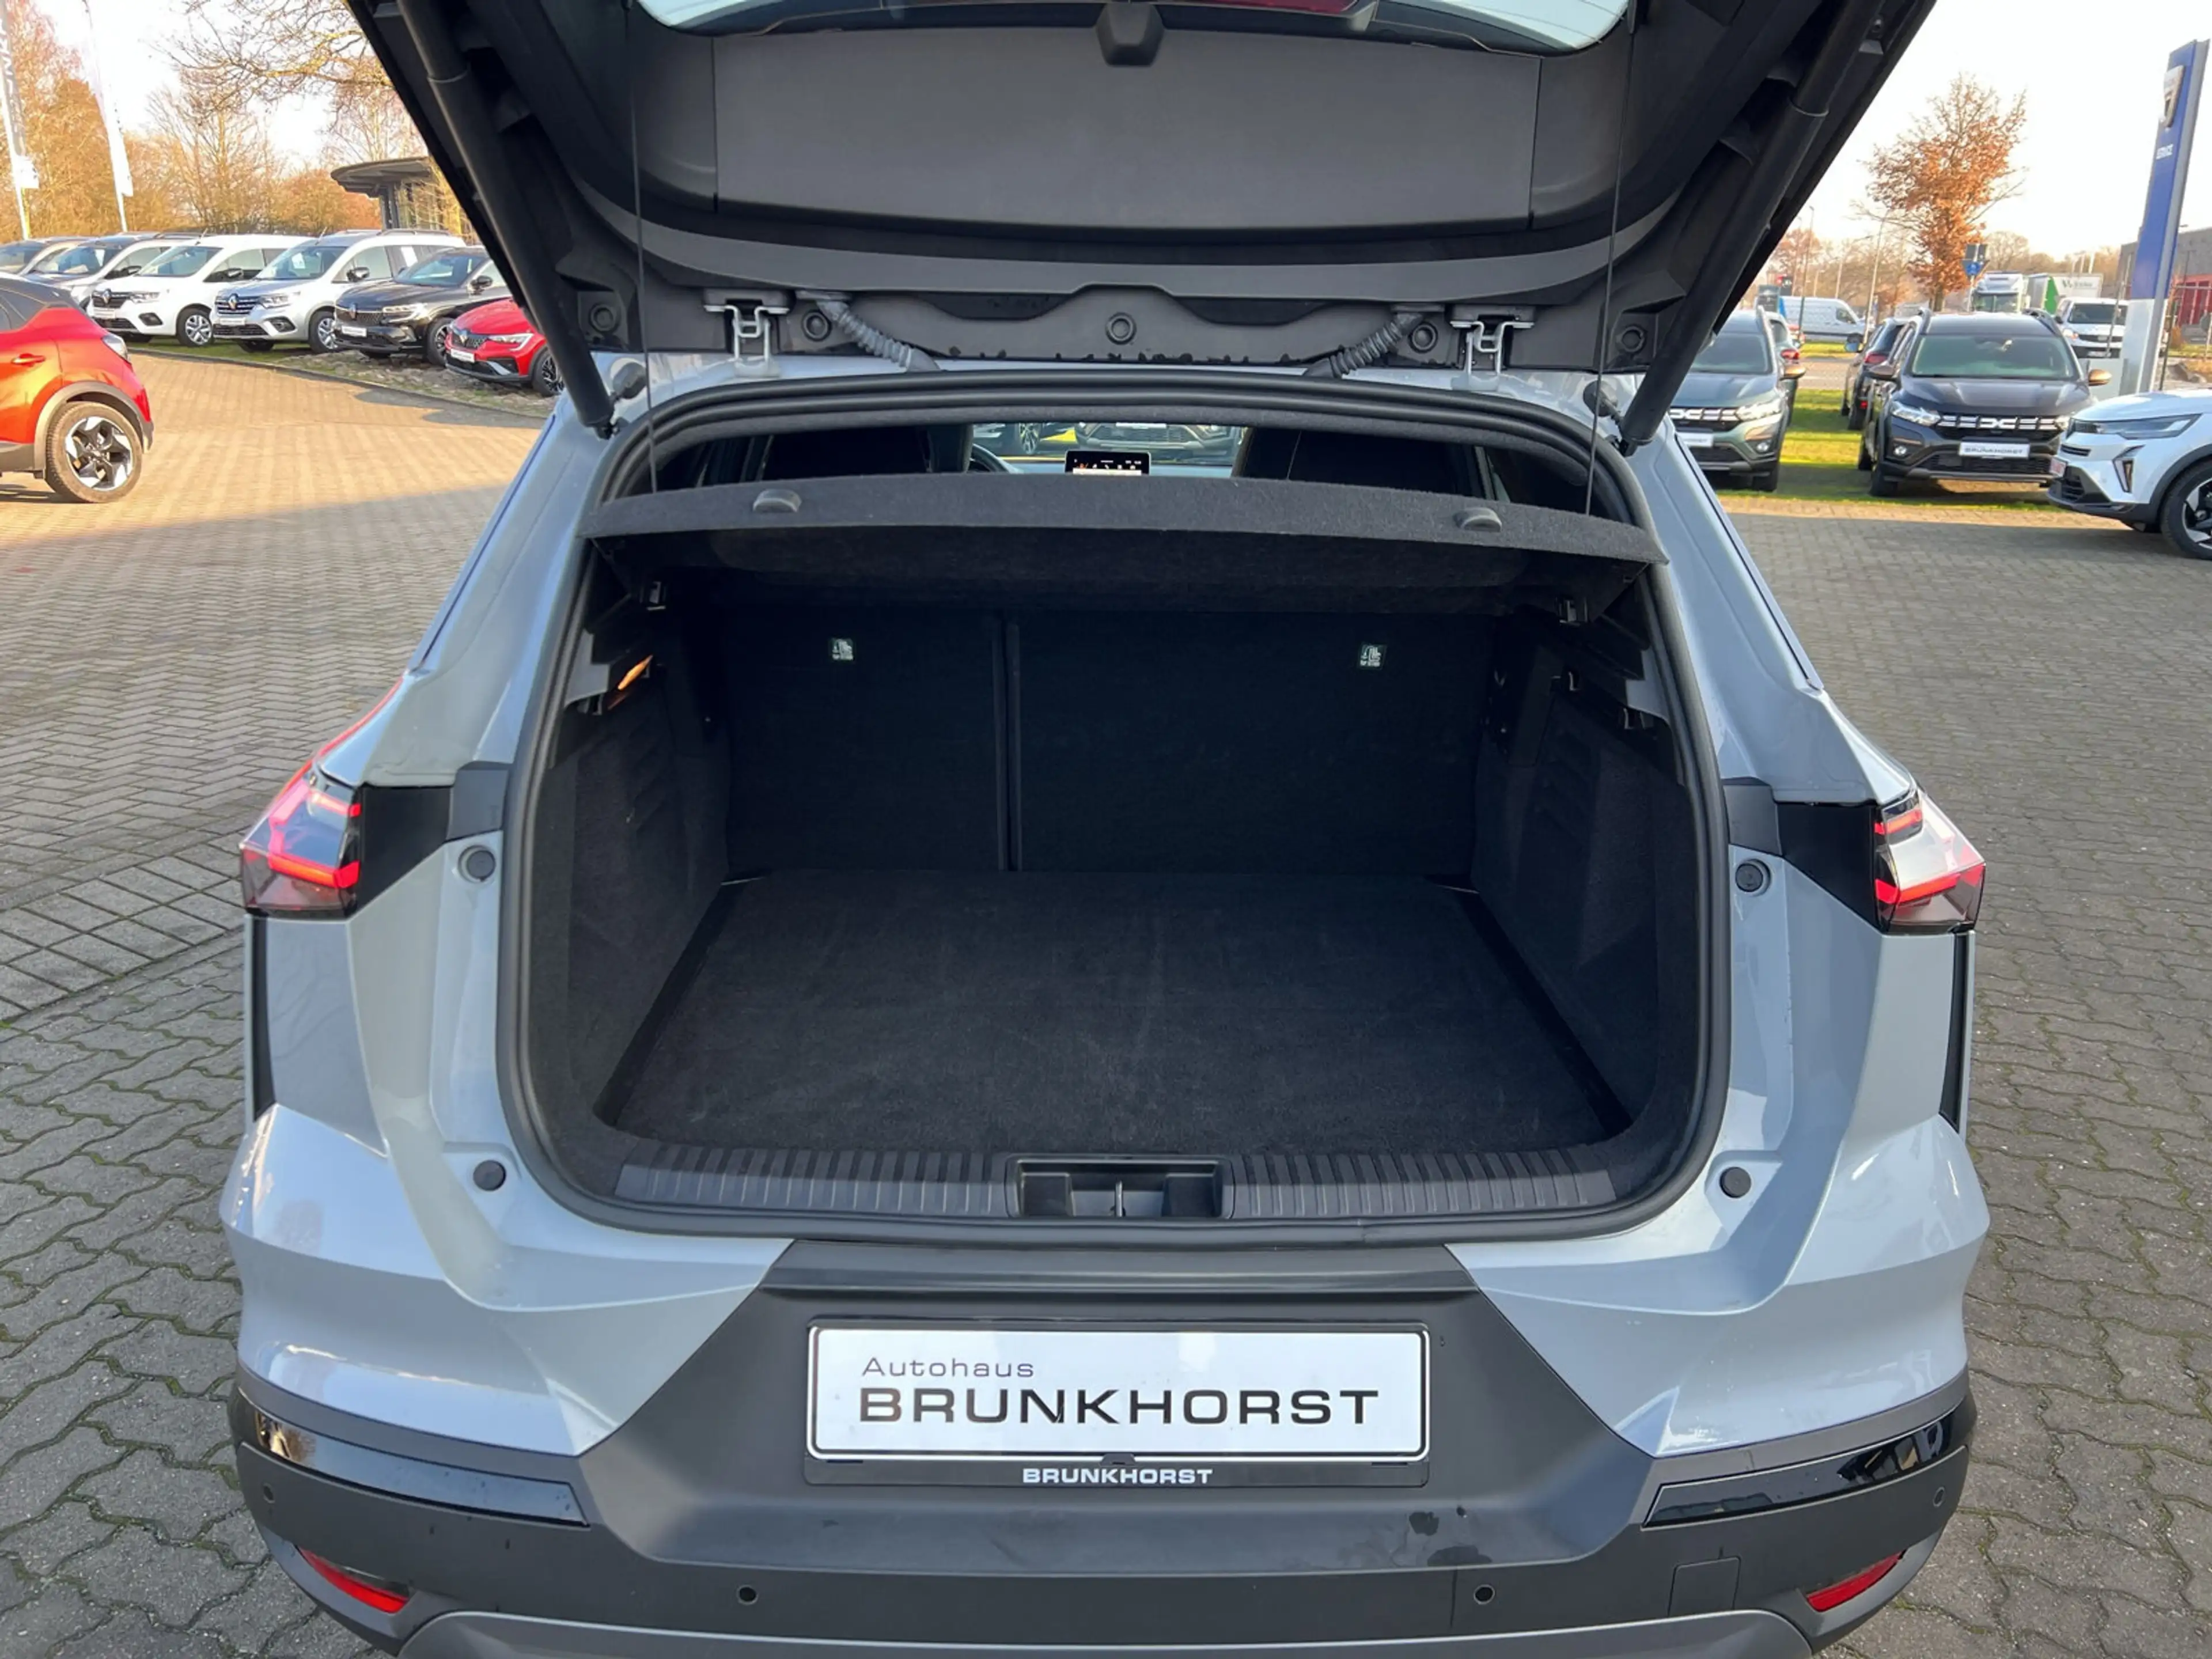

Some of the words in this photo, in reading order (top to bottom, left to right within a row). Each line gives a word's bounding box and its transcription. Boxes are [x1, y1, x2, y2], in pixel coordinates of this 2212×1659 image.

[862, 1357, 1035, 1378] Autohaus
[859, 1387, 1379, 1425] BRUNKHORST
[1022, 1468, 1213, 1484] BRUNKHORST
